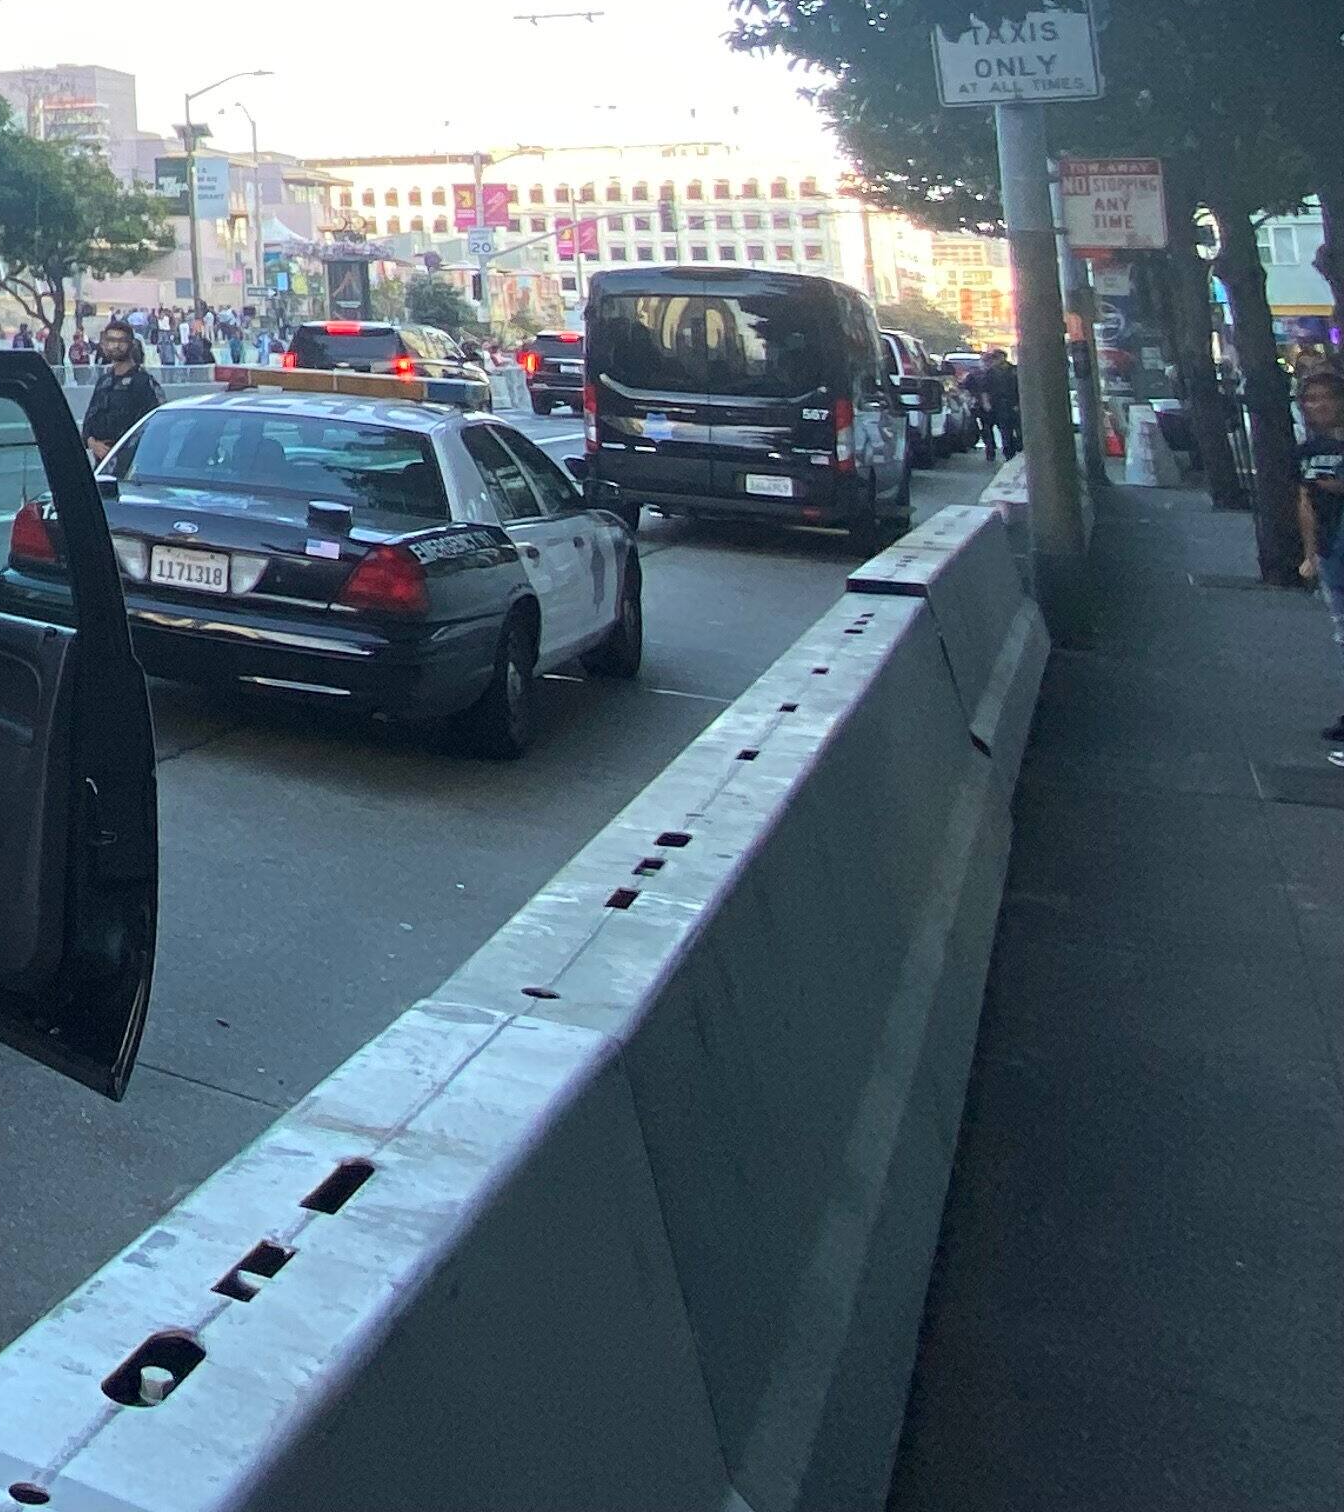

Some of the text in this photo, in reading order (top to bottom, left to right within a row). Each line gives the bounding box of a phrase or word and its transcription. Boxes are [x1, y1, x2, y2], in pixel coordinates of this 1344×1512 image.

[972, 21, 1059, 45] TAXIS
[975, 54, 1057, 78] ONLY
[959, 77, 1085, 93] AT ALL TIMES
[1063, 176, 1158, 194] NO STOPPING
[1094, 198, 1130, 211] ANY
[1094, 215, 1134, 229] TIME
[471, 242, 492, 253] 20
[157, 560, 222, 586] 1171318
